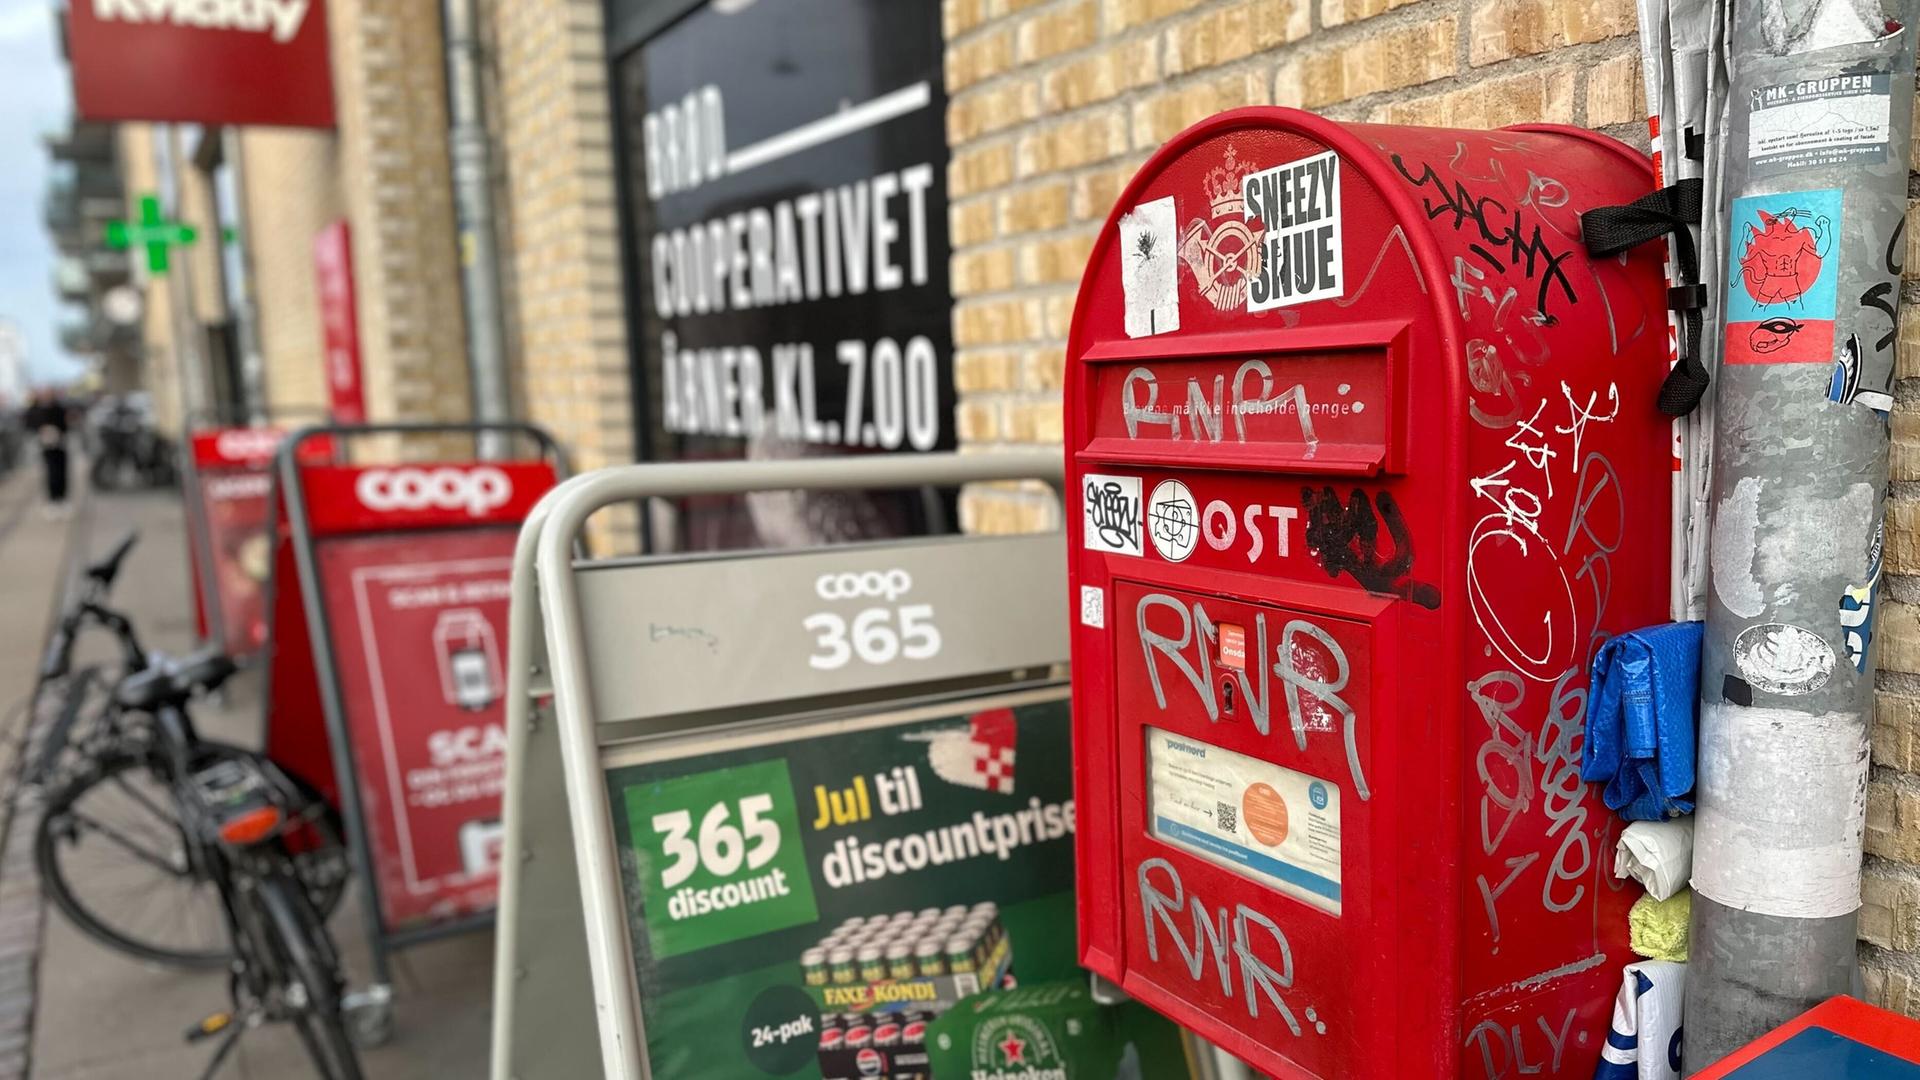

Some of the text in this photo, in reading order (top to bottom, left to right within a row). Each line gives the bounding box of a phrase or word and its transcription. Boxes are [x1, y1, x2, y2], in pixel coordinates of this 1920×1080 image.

[1766, 75, 1872, 101] MK-GRUPPEN
[1246, 155, 1336, 233] SNEEZY
[653, 162, 933, 319] COOPERATIVET
[661, 329, 767, 439] ÅBNER
[1226, 399, 1296, 415] indeholde
[1303, 402, 1350, 419] penge
[355, 467, 514, 517] coop
[1202, 499, 1298, 564] OST
[815, 567, 913, 602] coop
[802, 603, 943, 671] 365
[813, 765, 923, 831] Jul til
[652, 793, 781, 889] 365
[668, 867, 790, 920] discount
[823, 981, 937, 1006] FAXE KONDI
[751, 1014, 814, 1048] 24-pak
